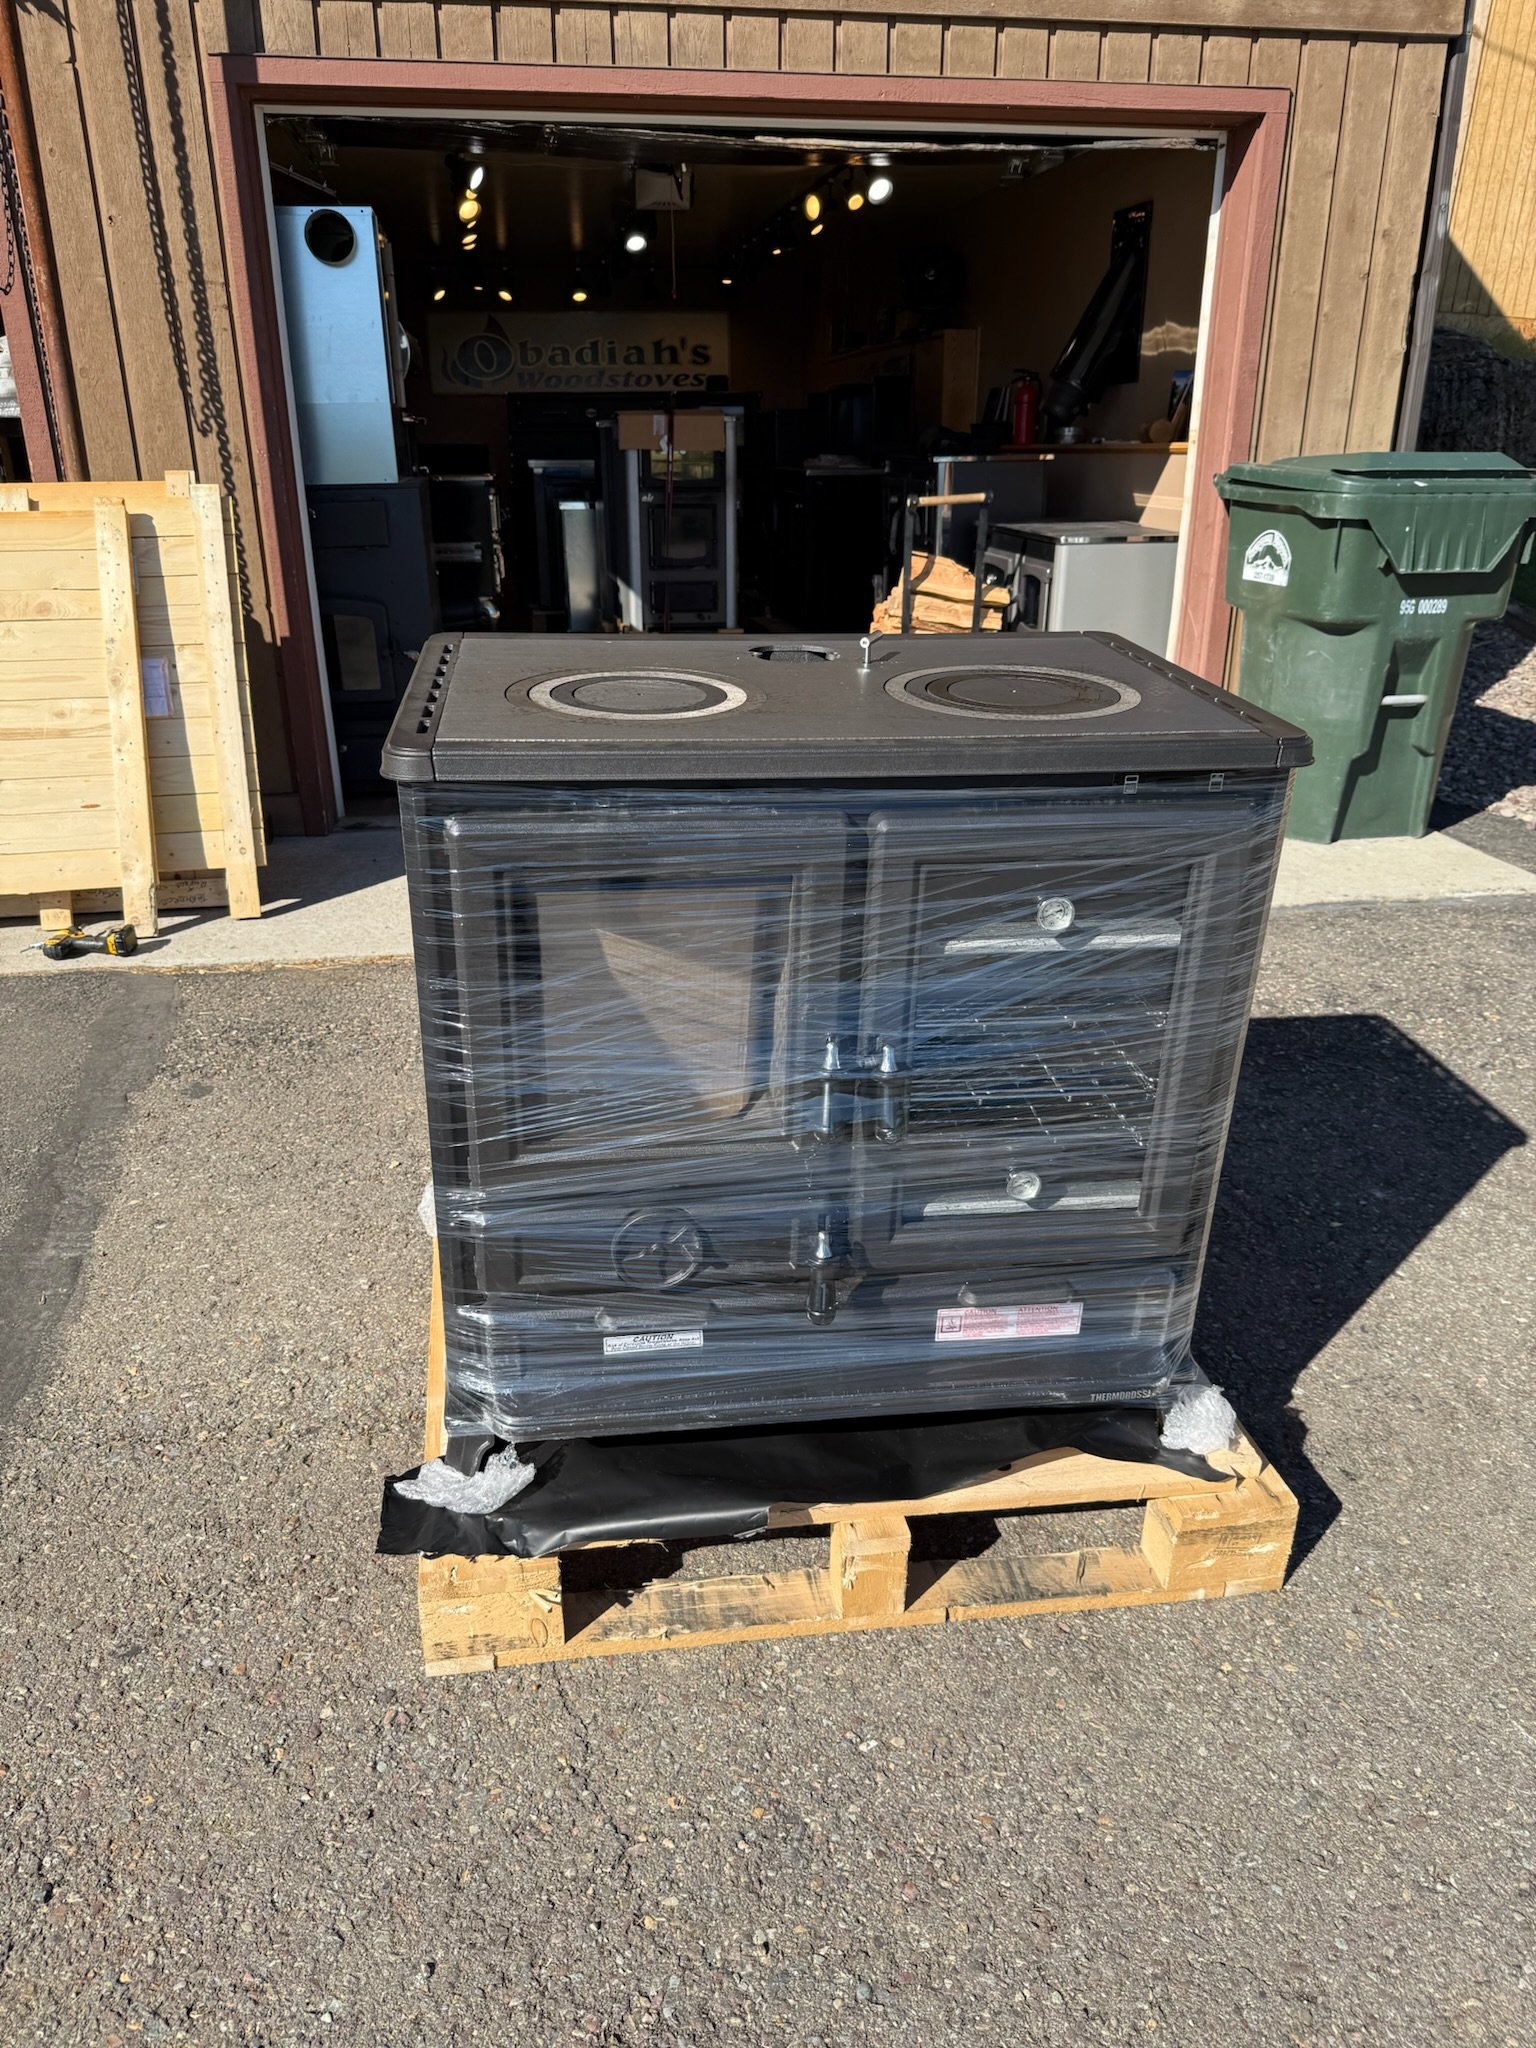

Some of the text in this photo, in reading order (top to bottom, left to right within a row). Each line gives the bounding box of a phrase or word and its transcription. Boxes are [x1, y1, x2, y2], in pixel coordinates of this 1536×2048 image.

[456, 333, 712, 381] Obadiah's
[516, 371, 706, 391] Woodstoves
[1418, 598, 1448, 615] 000289
[1018, 1305, 1059, 1314] ATTENTION
[633, 1333, 674, 1342] CAUTION
